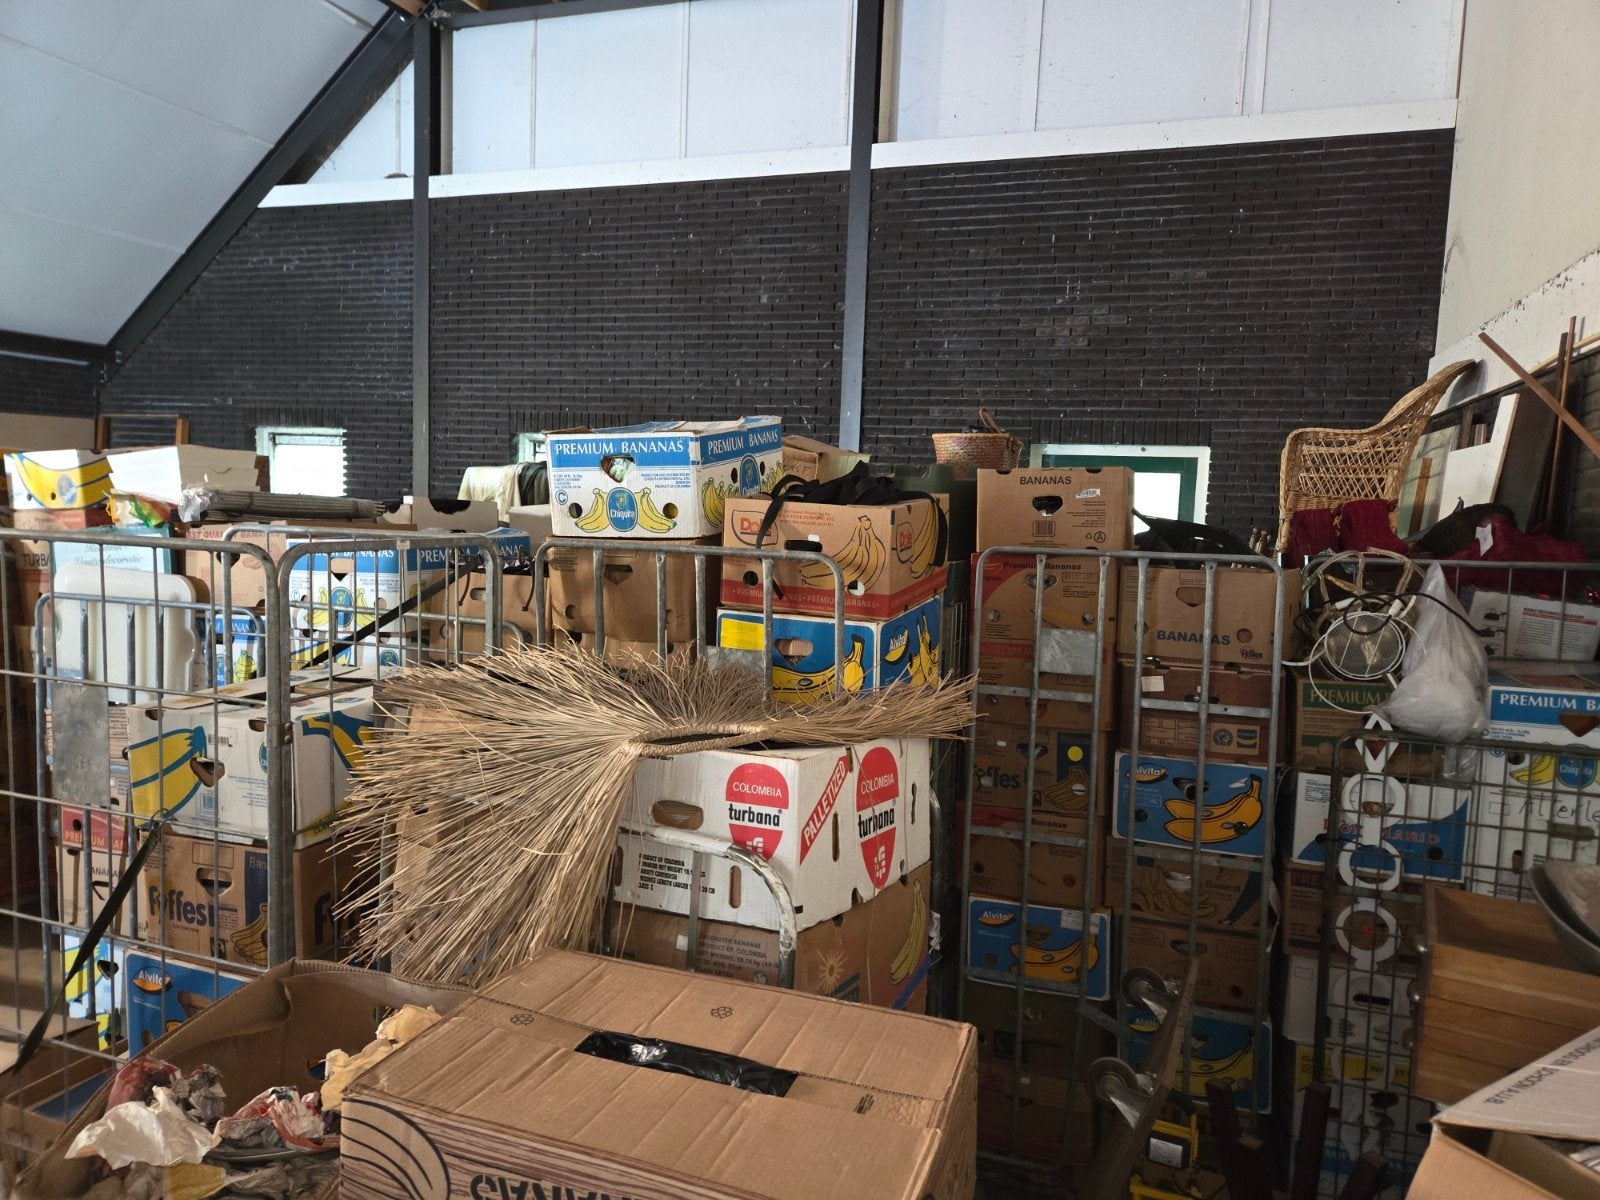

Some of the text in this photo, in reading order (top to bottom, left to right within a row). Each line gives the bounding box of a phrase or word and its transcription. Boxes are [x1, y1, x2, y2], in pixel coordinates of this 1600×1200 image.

[555, 440, 684, 455] PREMIUM BANANAS
[709, 430, 778, 455] PREMIUM BANANAS
[1019, 476, 1072, 485] BANANAS
[1044, 562, 1082, 570] Bananas
[736, 588, 764, 598] PREMIU
[807, 595, 835, 605] PREMIU
[1310, 689, 1381, 705] PREMIUM
[1500, 693, 1577, 710] PREMIUM
[732, 781, 782, 798] COLOMBIA
[861, 773, 895, 795] COLOMBIA
[803, 759, 848, 847] PALLETIZED
[728, 803, 780, 827] turbana
[858, 808, 895, 838] turbana
[1031, 817, 1068, 829] Bananas
[667, 865, 683, 874] WEIGHT
[1206, 878, 1241, 892] Banacol
[733, 938, 761, 949] BANANAS
[736, 948, 767, 959] COLOMBIA
